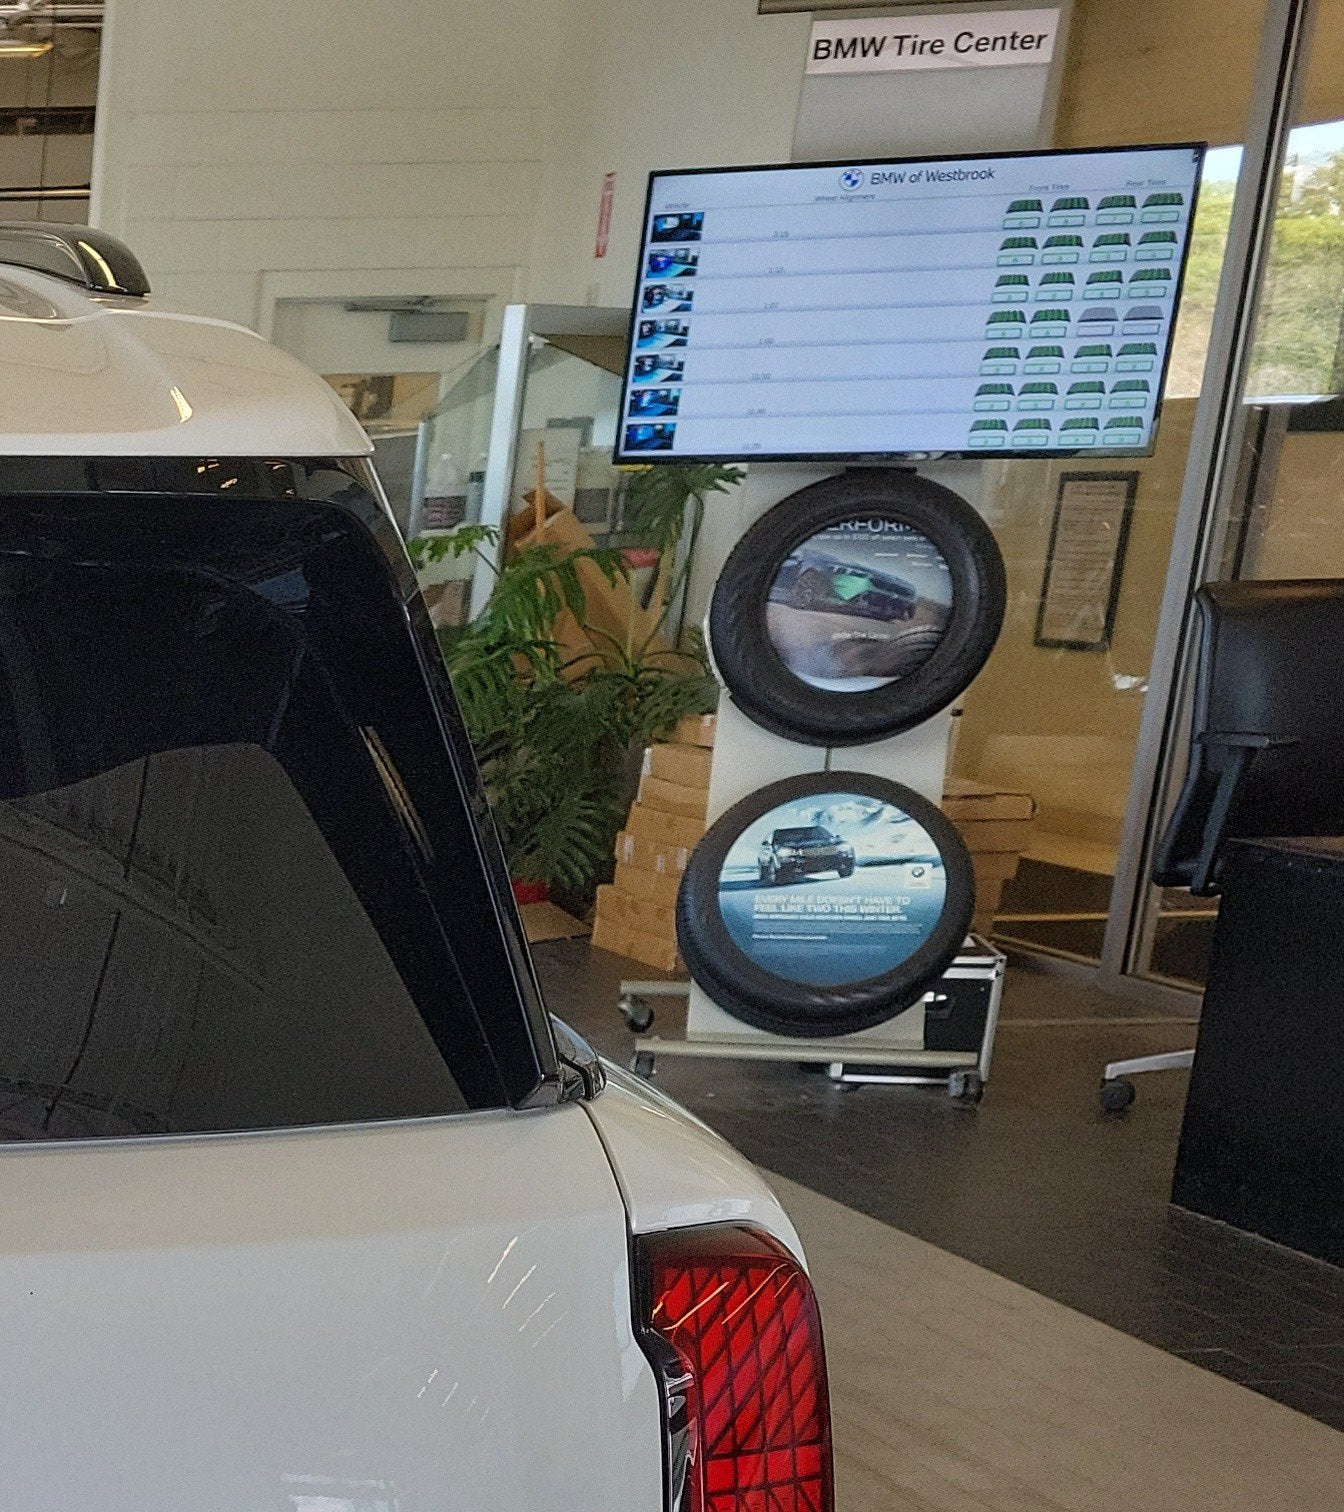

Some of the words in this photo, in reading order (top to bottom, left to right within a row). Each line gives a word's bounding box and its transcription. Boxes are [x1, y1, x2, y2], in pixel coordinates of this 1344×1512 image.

[813, 36, 887, 60] BMW
[893, 34, 945, 56] Tire
[954, 31, 1048, 53] Center
[871, 171, 907, 185] BMW
[909, 170, 924, 183] of
[926, 167, 997, 182] Westbrook
